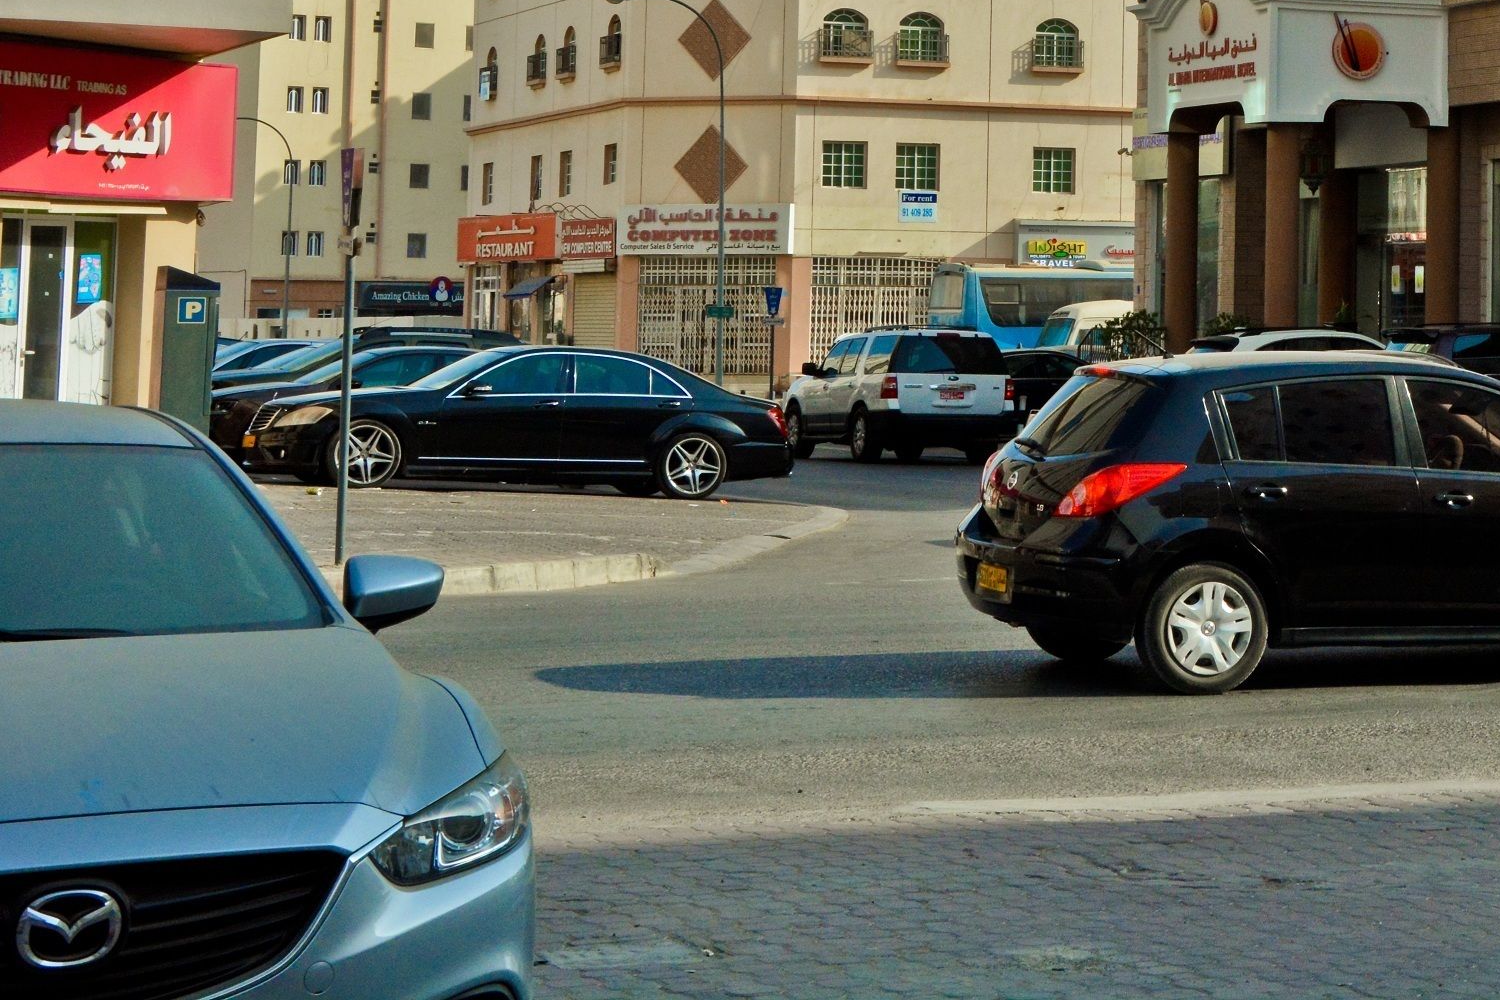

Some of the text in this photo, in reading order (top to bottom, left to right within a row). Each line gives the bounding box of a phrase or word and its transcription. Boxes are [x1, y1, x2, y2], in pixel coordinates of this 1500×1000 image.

[50, 74, 71, 90] LLC
[77, 80, 113, 94] TRADING
[115, 84, 127, 95] AS
[51, 105, 172, 170] الفيحاء
[903, 194, 916, 202] For
[477, 219, 535, 240] مطعم
[729, 229, 777, 242] ZONE
[476, 241, 534, 258] RESTAURANT
[571, 242, 594, 254] COMPUTER
[595, 241, 612, 253] CENTRE
[620, 243, 649, 251] Computer
[371, 291, 430, 303] Amazing Chicken
[186, 302, 202, 319] P
